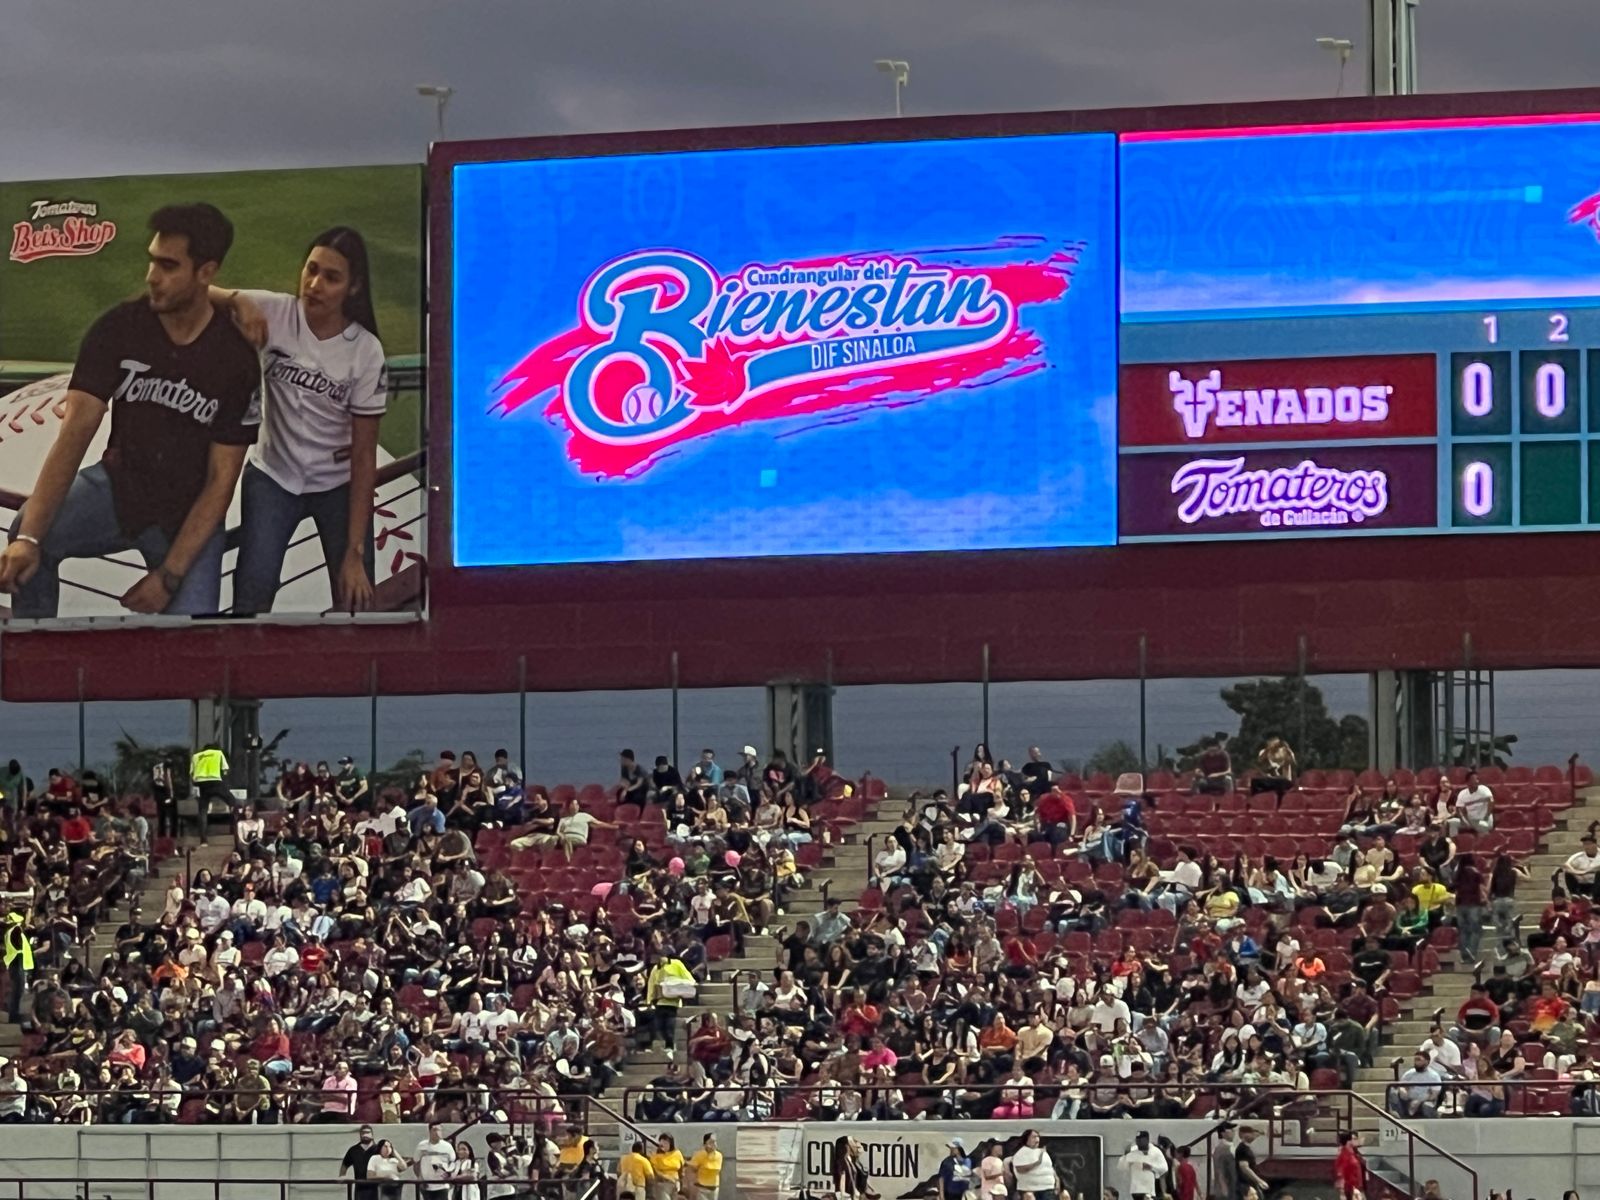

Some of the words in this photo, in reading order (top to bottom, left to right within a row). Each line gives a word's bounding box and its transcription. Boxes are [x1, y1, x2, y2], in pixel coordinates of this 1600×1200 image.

[11, 221, 60, 255] Beis
[60, 216, 117, 250] Shop
[747, 265, 859, 287] Cuadrangular
[864, 263, 889, 281] del
[563, 248, 1012, 445] Bienestar
[811, 342, 839, 370] DIF
[842, 336, 916, 364] SINALOA
[1483, 315, 1498, 344] 1
[1549, 314, 1569, 343] 2
[114, 359, 219, 426] Tomatero
[1169, 369, 1394, 438] VENADOS
[1462, 362, 1493, 418] 0
[1535, 362, 1566, 418] 0
[1171, 456, 1388, 524] Tomateros
[1462, 461, 1494, 517] 0
[1260, 510, 1281, 526] de
